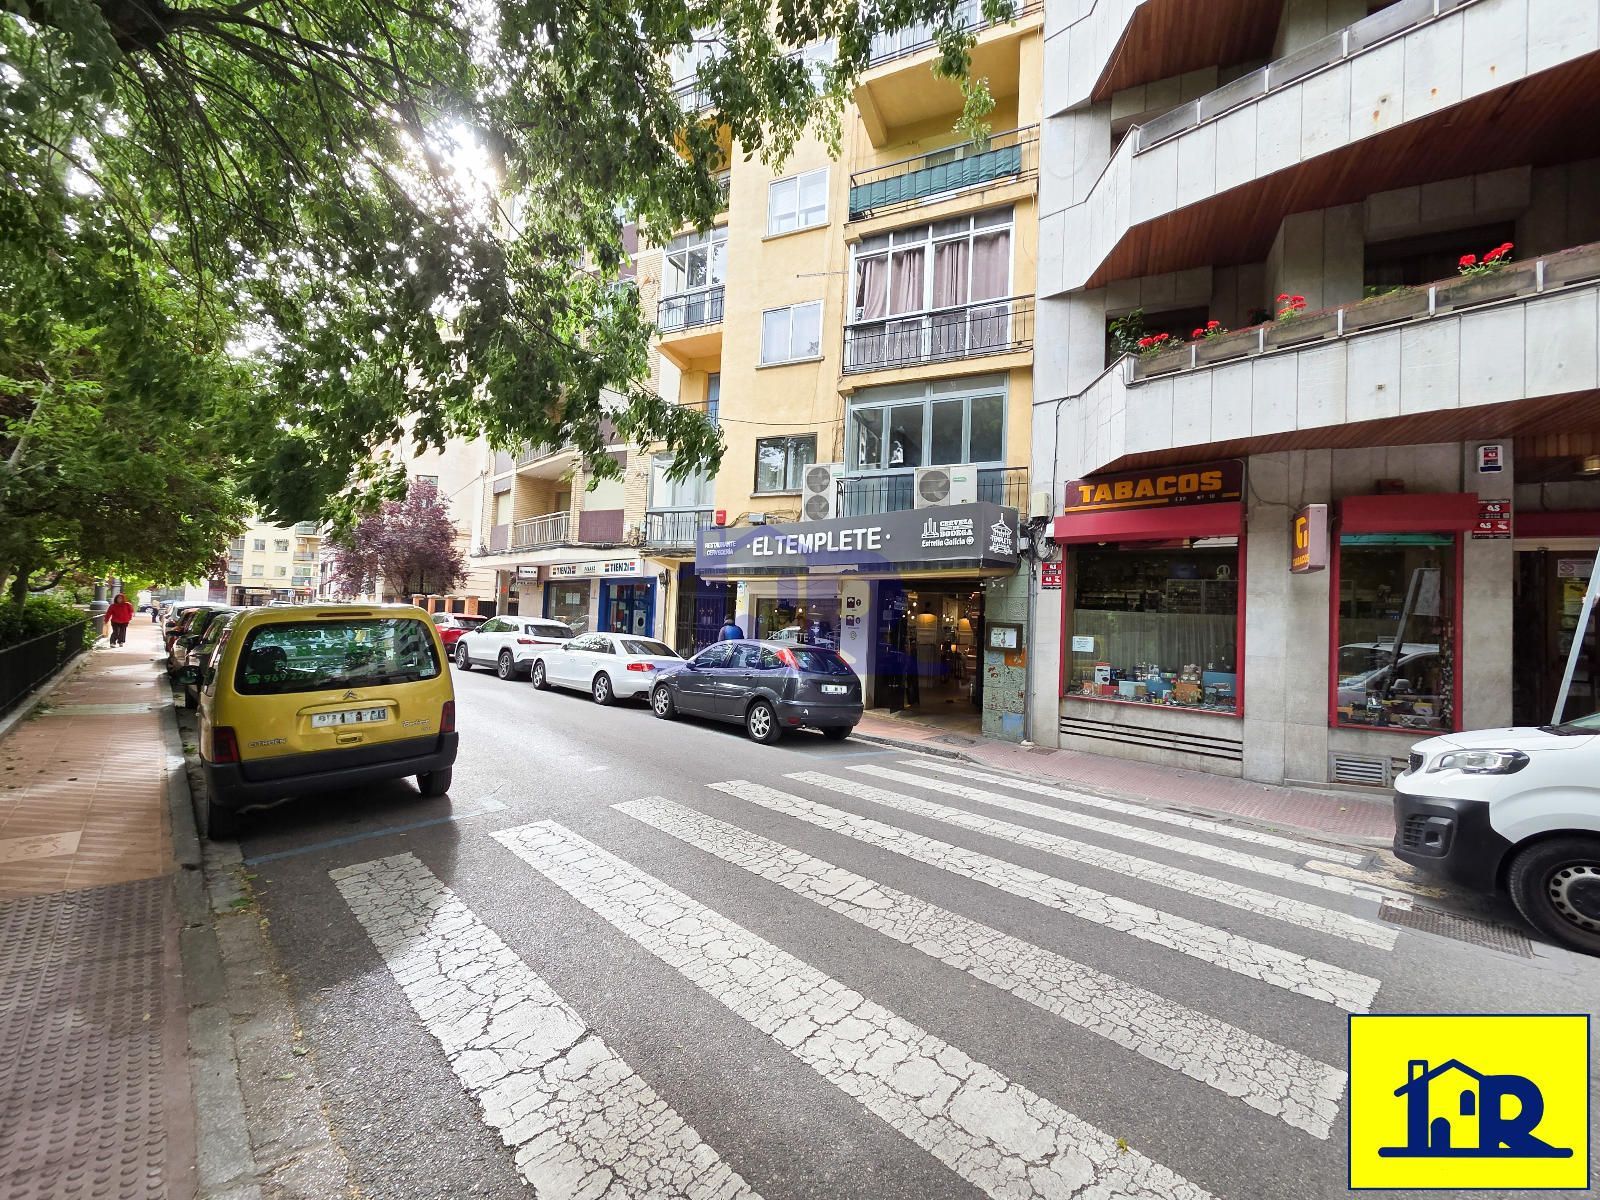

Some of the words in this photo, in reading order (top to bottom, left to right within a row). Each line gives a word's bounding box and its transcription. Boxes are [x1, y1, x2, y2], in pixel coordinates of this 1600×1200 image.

[1078, 470, 1223, 503] TABACOS
[752, 536, 774, 556] EL
[774, 527, 882, 554] TEMPLETE
[921, 539, 944, 548] Estrella
[944, 537, 966, 546] Galicia
[939, 528, 973, 538] BODEGA
